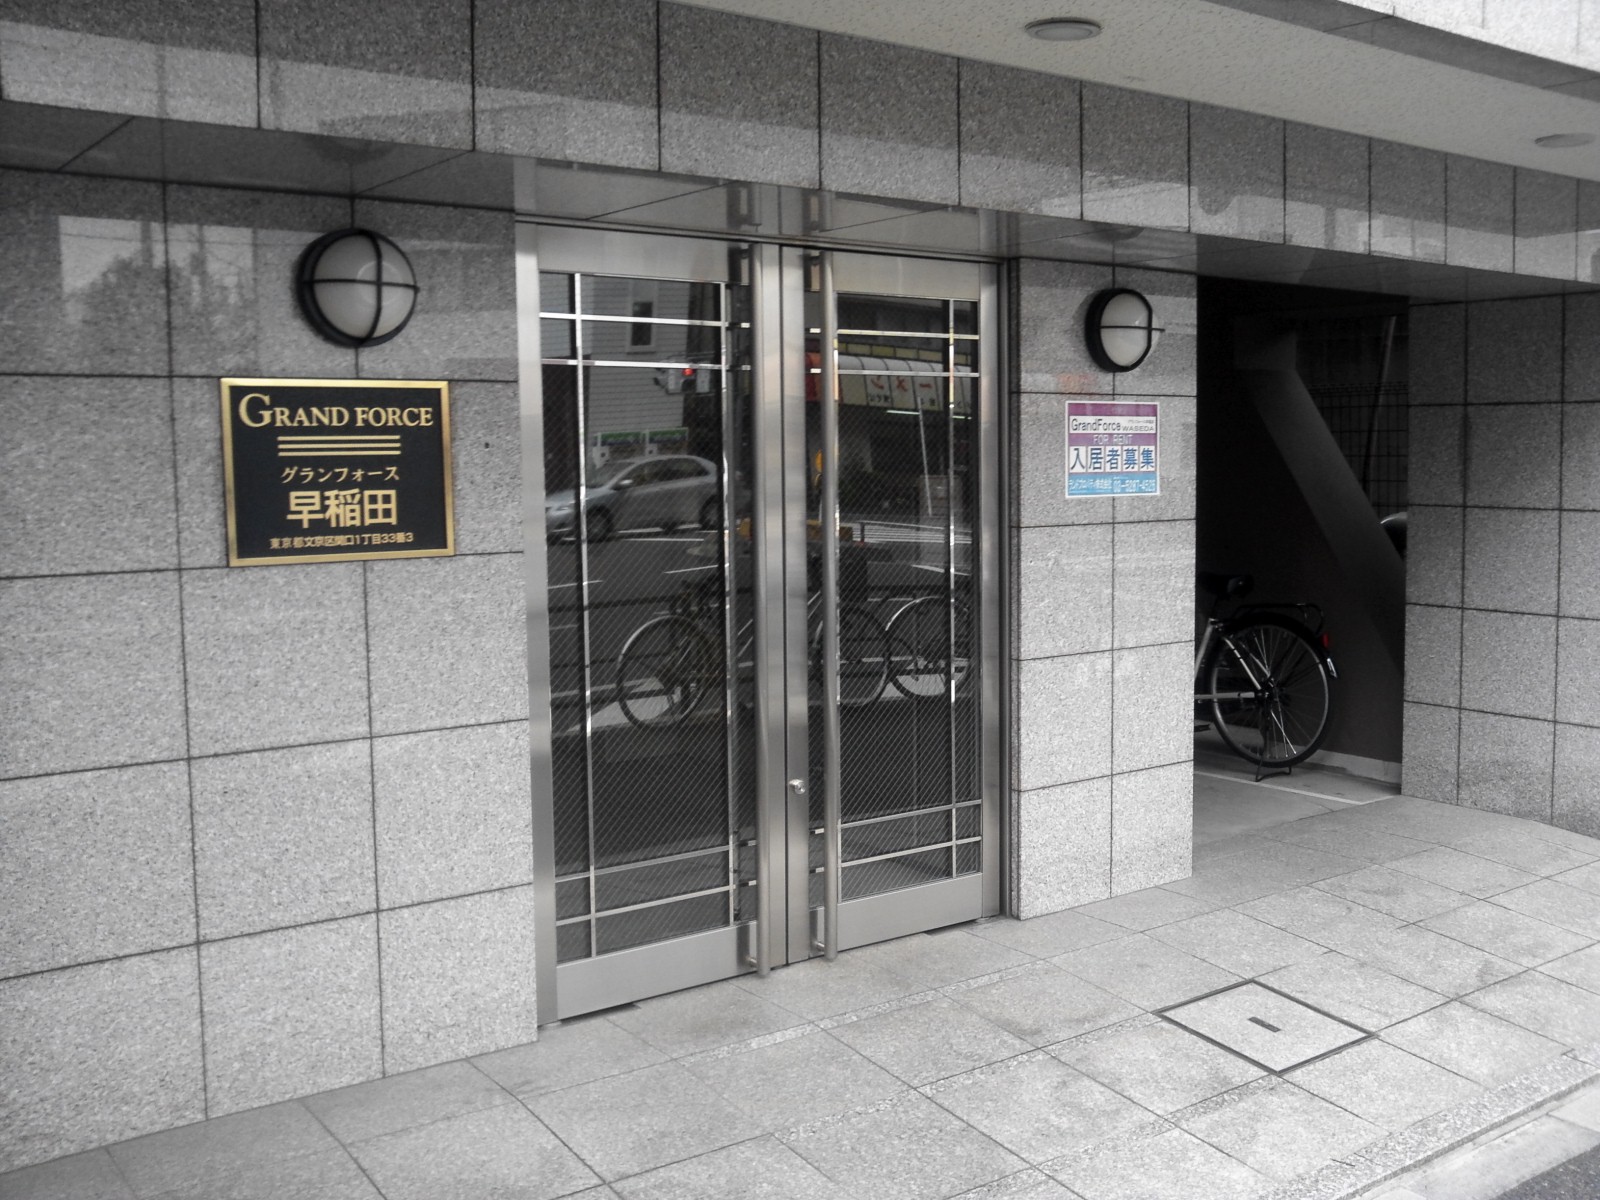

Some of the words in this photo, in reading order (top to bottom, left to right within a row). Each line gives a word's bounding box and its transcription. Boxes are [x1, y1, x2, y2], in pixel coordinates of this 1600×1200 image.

[238, 392, 350, 428] GRAND
[353, 406, 434, 428] FORCE
[1093, 435, 1109, 445] FOR
[1113, 434, 1132, 445] RENT
[1070, 448, 1154, 470] 入居者募集
[280, 465, 401, 484] グランフォース
[286, 488, 398, 529] 早稲田
